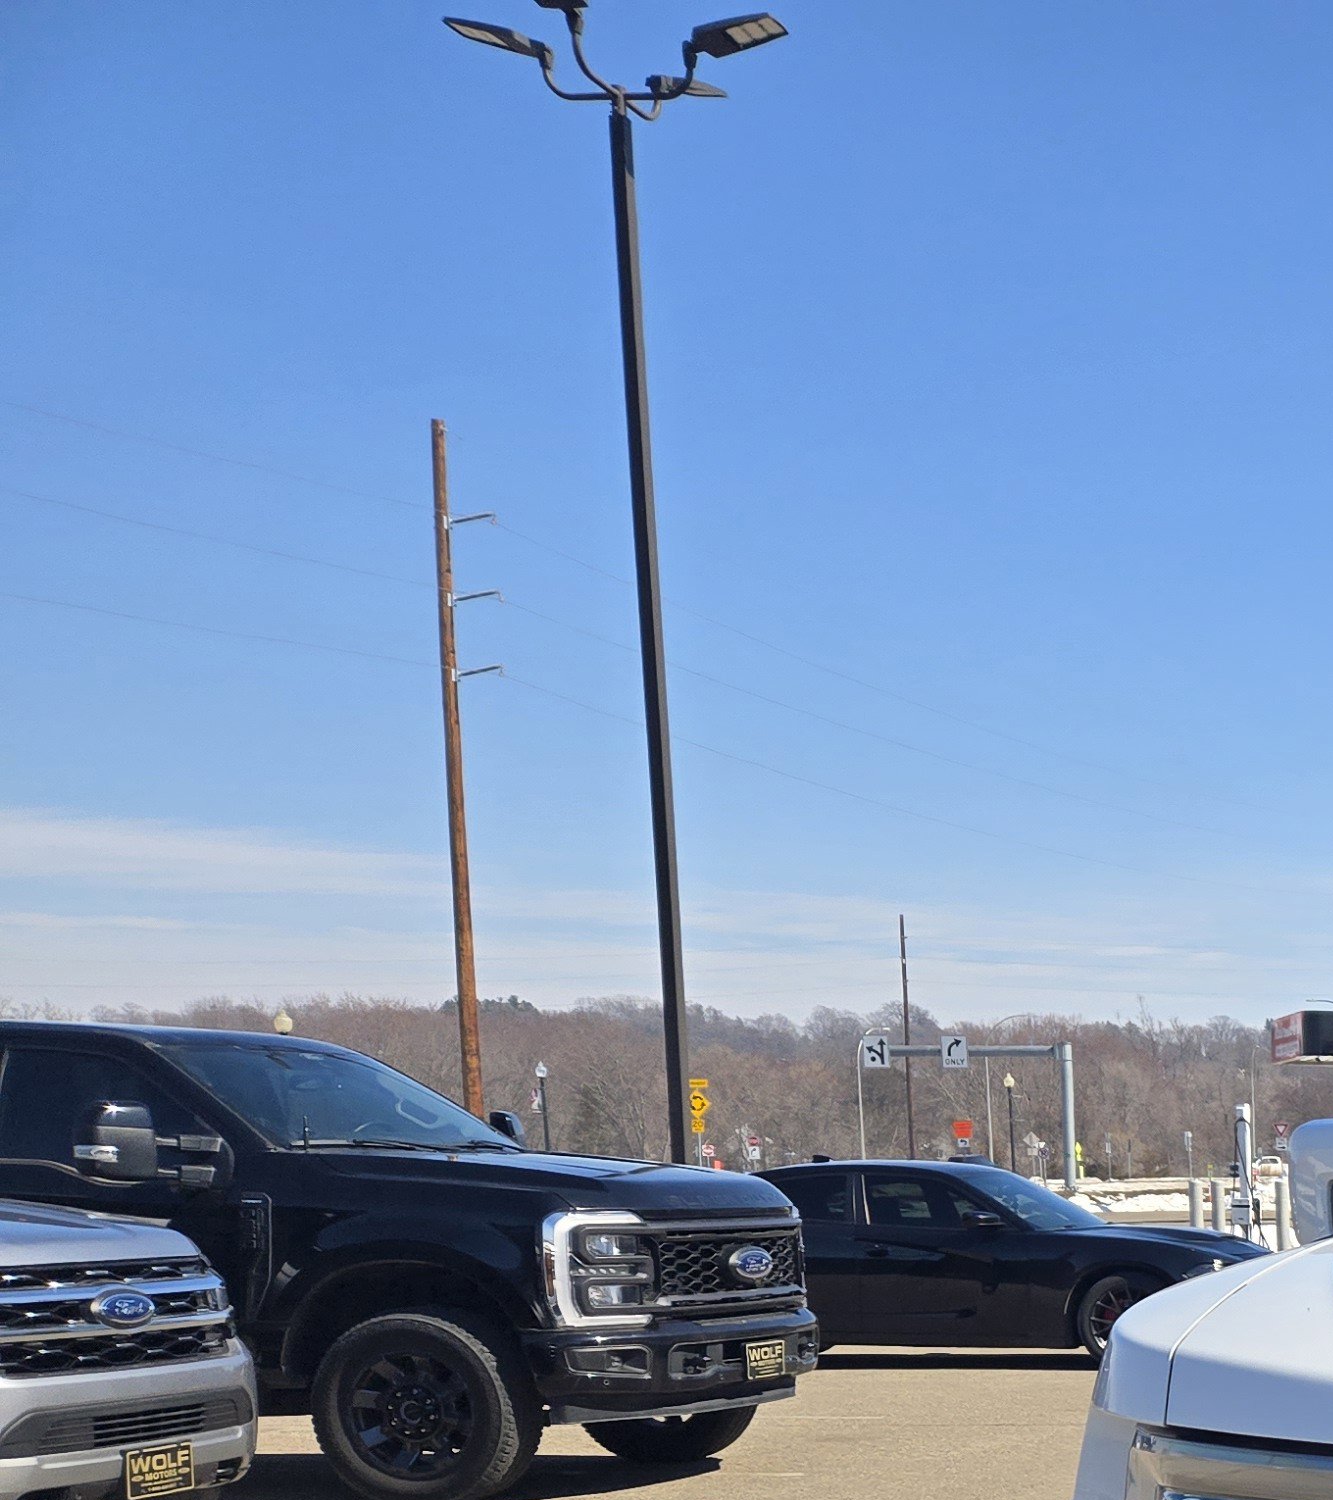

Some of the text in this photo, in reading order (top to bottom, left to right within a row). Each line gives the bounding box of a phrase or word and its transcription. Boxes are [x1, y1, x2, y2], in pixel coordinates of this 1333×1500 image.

[945, 1058, 965, 1066] ONLY
[749, 1345, 782, 1361] WOLF
[130, 1450, 189, 1474] WOLF
